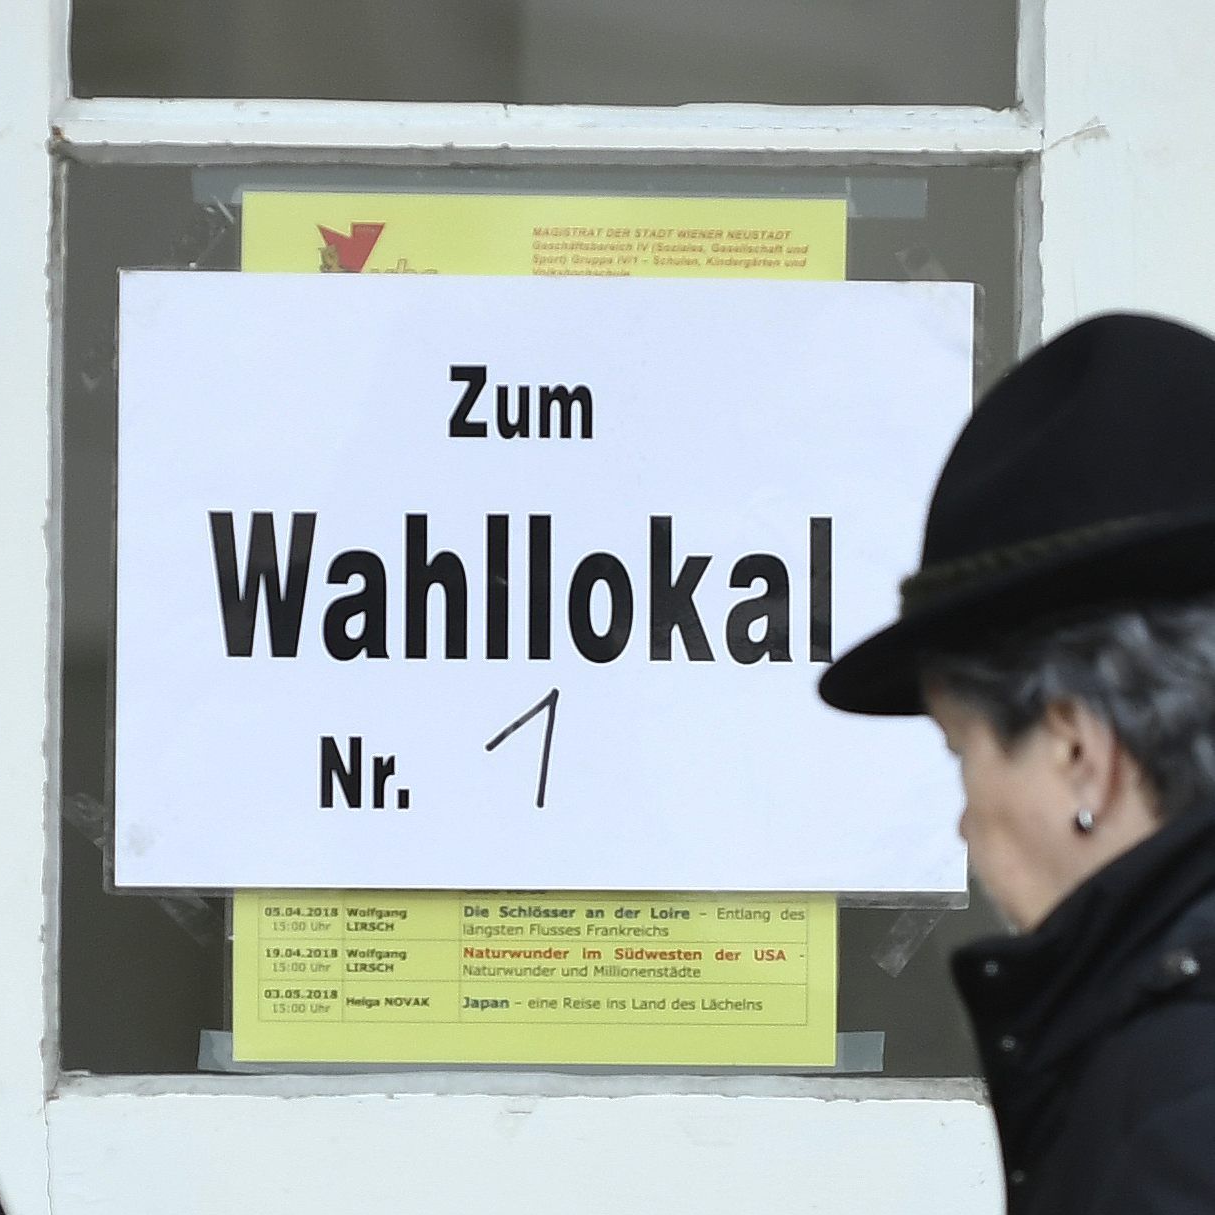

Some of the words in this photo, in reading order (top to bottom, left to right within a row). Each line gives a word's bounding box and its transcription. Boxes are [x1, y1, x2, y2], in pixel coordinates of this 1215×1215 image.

[533, 227, 603, 237] MAGISTRAT
[606, 228, 631, 238] DER
[634, 228, 674, 238] STADT
[677, 229, 724, 239] WIENER
[726, 230, 792, 240] NEUSTADT
[711, 243, 783, 253] Gesellschaft
[786, 244, 809, 254] und
[532, 254, 567, 265] Sport)
[571, 254, 613, 266] Gruppe
[705, 256, 781, 268] Kindergärten
[785, 258, 807, 267] und
[448, 365, 594, 439] Zum
[207, 510, 834, 664] Wahllokal
[319, 736, 411, 809] Nr.
[486, 688, 559, 808] 1
[264, 907, 338, 918] 05.04.2018
[346, 907, 408, 920] Wolfgang
[464, 905, 490, 918] Die
[499, 905, 576, 919] Schlösser
[585, 908, 605, 919] an
[614, 906, 641, 919] der
[650, 907, 690, 920] Loire
[717, 907, 771, 922] Entlang
[780, 908, 805, 921] des
[273, 922, 306, 932] 15:00
[310, 921, 332, 932] Uhr
[346, 922, 395, 932] LIRSCH
[463, 923, 524, 938] längsten
[529, 923, 581, 936] Flusses
[586, 924, 669, 937] Frankreichs
[265, 948, 338, 959] 19.04.2018
[346, 949, 408, 961] Wolfgang
[464, 947, 570, 960] Naturwunder
[582, 947, 602, 960] im
[614, 947, 703, 961] Südwesten
[714, 949, 741, 961] der
[753, 949, 787, 962] USA
[273, 963, 306, 973] 15:00
[310, 962, 332, 973] Uhr
[346, 963, 395, 973] LIRSCH
[463, 964, 556, 977] Naturwunder
[561, 965, 588, 977] und
[593, 965, 702, 978] Millionenstädte
[264, 989, 338, 1000] 03.05.2018
[273, 1004, 306, 1014] 15:00
[310, 1003, 332, 1014] Uhr
[346, 997, 381, 1009] Helga
[385, 997, 430, 1008] NOVAK
[463, 996, 510, 1011] Japan
[527, 997, 558, 1010] eine
[563, 997, 601, 1010] Reise
[606, 998, 627, 1010] ins
[632, 998, 667, 1010] Land
[671, 998, 696, 1010] des
[701, 998, 763, 1011] Lächelns
